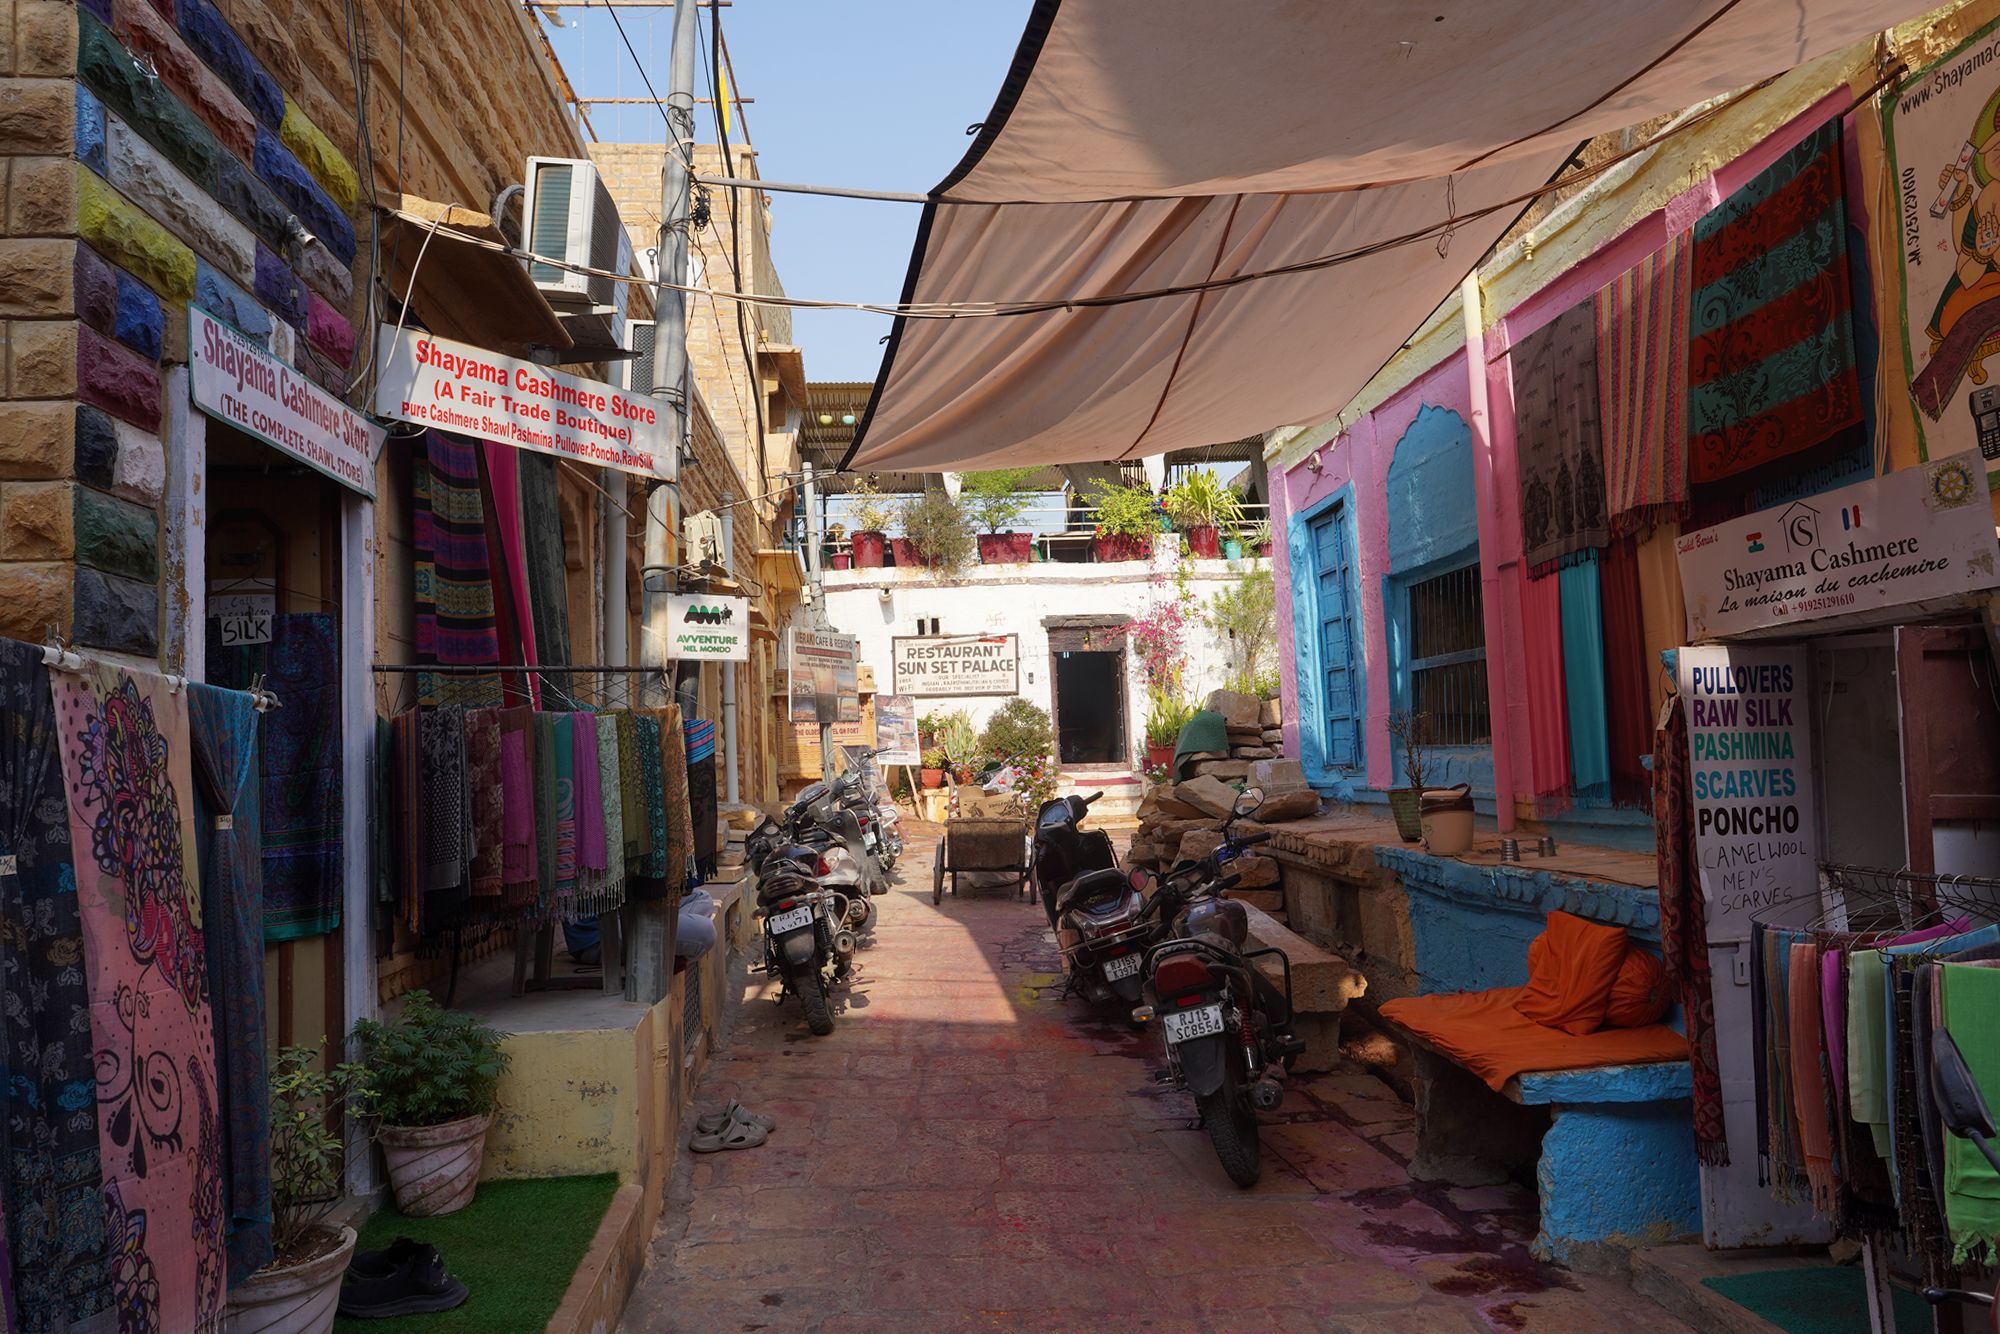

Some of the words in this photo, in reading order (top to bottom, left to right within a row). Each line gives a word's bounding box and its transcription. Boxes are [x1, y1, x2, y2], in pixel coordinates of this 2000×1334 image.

[203, 318, 276, 400] Shayama
[280, 366, 340, 439] Cashmere
[342, 409, 369, 457] Store
[416, 340, 508, 387] Shayama
[515, 368, 605, 412] Cashmere
[611, 395, 655, 425] Store
[430, 402, 479, 430] Cashmere
[481, 416, 510, 440] Shawl
[511, 423, 553, 448] Pashmina
[433, 379, 454, 400] (A
[461, 385, 495, 408] Fair
[501, 395, 550, 422] Trade
[556, 410, 632, 445] Boutique)
[220, 393, 248, 423] (THE
[252, 409, 304, 453] COMPLETE
[307, 439, 336, 471] SHAWL
[337, 457, 364, 488] STORE)
[1723, 560, 1807, 592] Shayama
[1810, 536, 1919, 573] Cashmere
[1717, 595, 1739, 614] La
[1744, 587, 1807, 610] maison
[1815, 577, 1840, 594] du
[1848, 556, 1949, 588] cachemire
[676, 634, 738, 645] AVVENTURE
[816, 635, 828, 647] CAFE
[829, 637, 833, 647] &
[907, 645, 1004, 659] RESTAURANT
[898, 661, 927, 675] SUN
[931, 661, 958, 674] SET
[962, 659, 1014, 673] PALACE
[1692, 665, 1793, 695] PULLOVERS
[1693, 698, 1738, 727] RAW
[1745, 698, 1793, 727] SILK
[1694, 732, 1795, 761] PASHMINA
[1695, 768, 1796, 800] SCARVES
[1699, 805, 1799, 837] PONCHO
[1723, 865, 1776, 891] MEN'S
[1722, 887, 1793, 915] SCARVES
[1110, 955, 1136, 970] RJ15S
[1176, 1018, 1221, 1040] SC8554
[1179, 1008, 1210, 1026] RJ15
